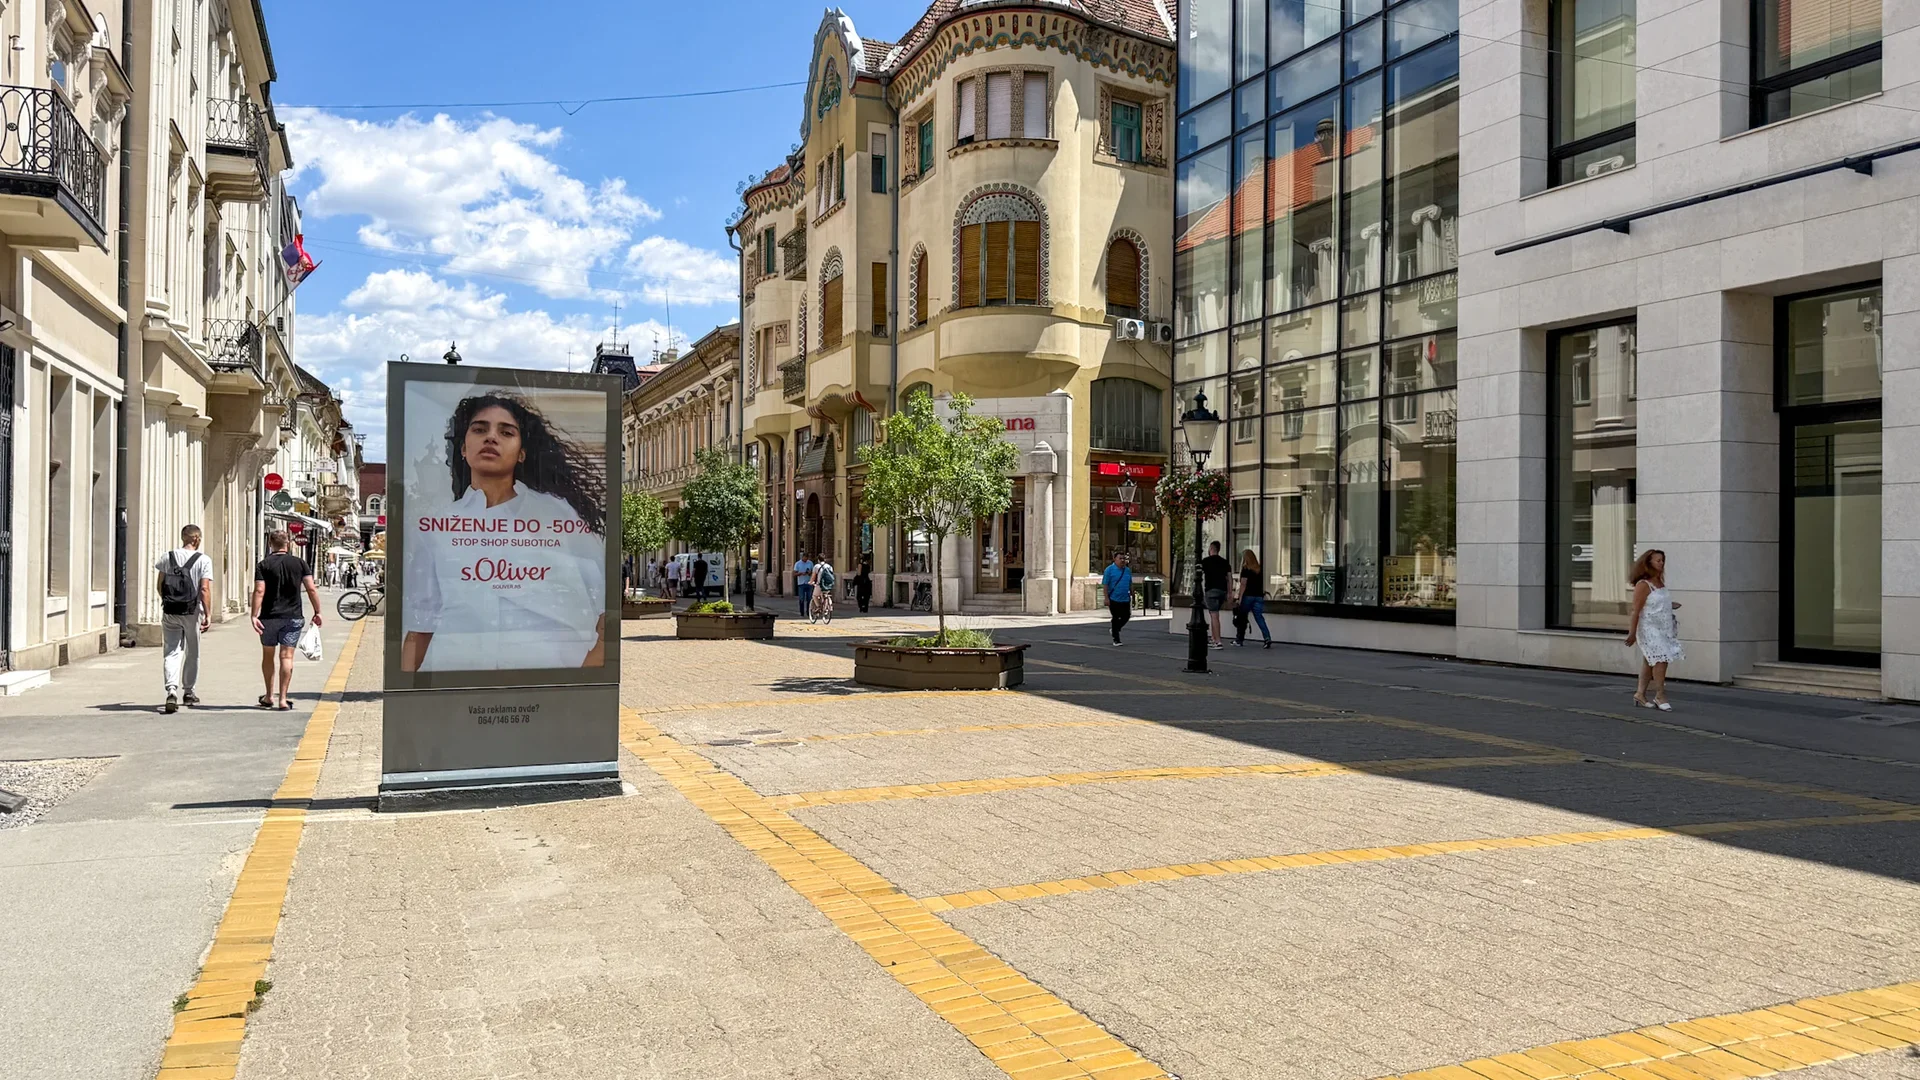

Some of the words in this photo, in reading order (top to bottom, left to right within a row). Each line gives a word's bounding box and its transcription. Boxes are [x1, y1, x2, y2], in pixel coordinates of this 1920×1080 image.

[419, 515, 508, 533] SNIŽENJE
[513, 519, 541, 533] DO
[546, 519, 592, 534] -50%
[451, 538, 479, 547] STOP
[480, 538, 509, 547] SHOP
[510, 538, 561, 547] SUBOTICA
[460, 557, 552, 582] s.Oliver
[468, 705, 486, 714] Vaša
[487, 704, 517, 714] reklama
[518, 703, 540, 713] ovde?
[477, 714, 509, 726] 064/146
[510, 714, 520, 724] 56
[521, 714, 530, 723] 78
